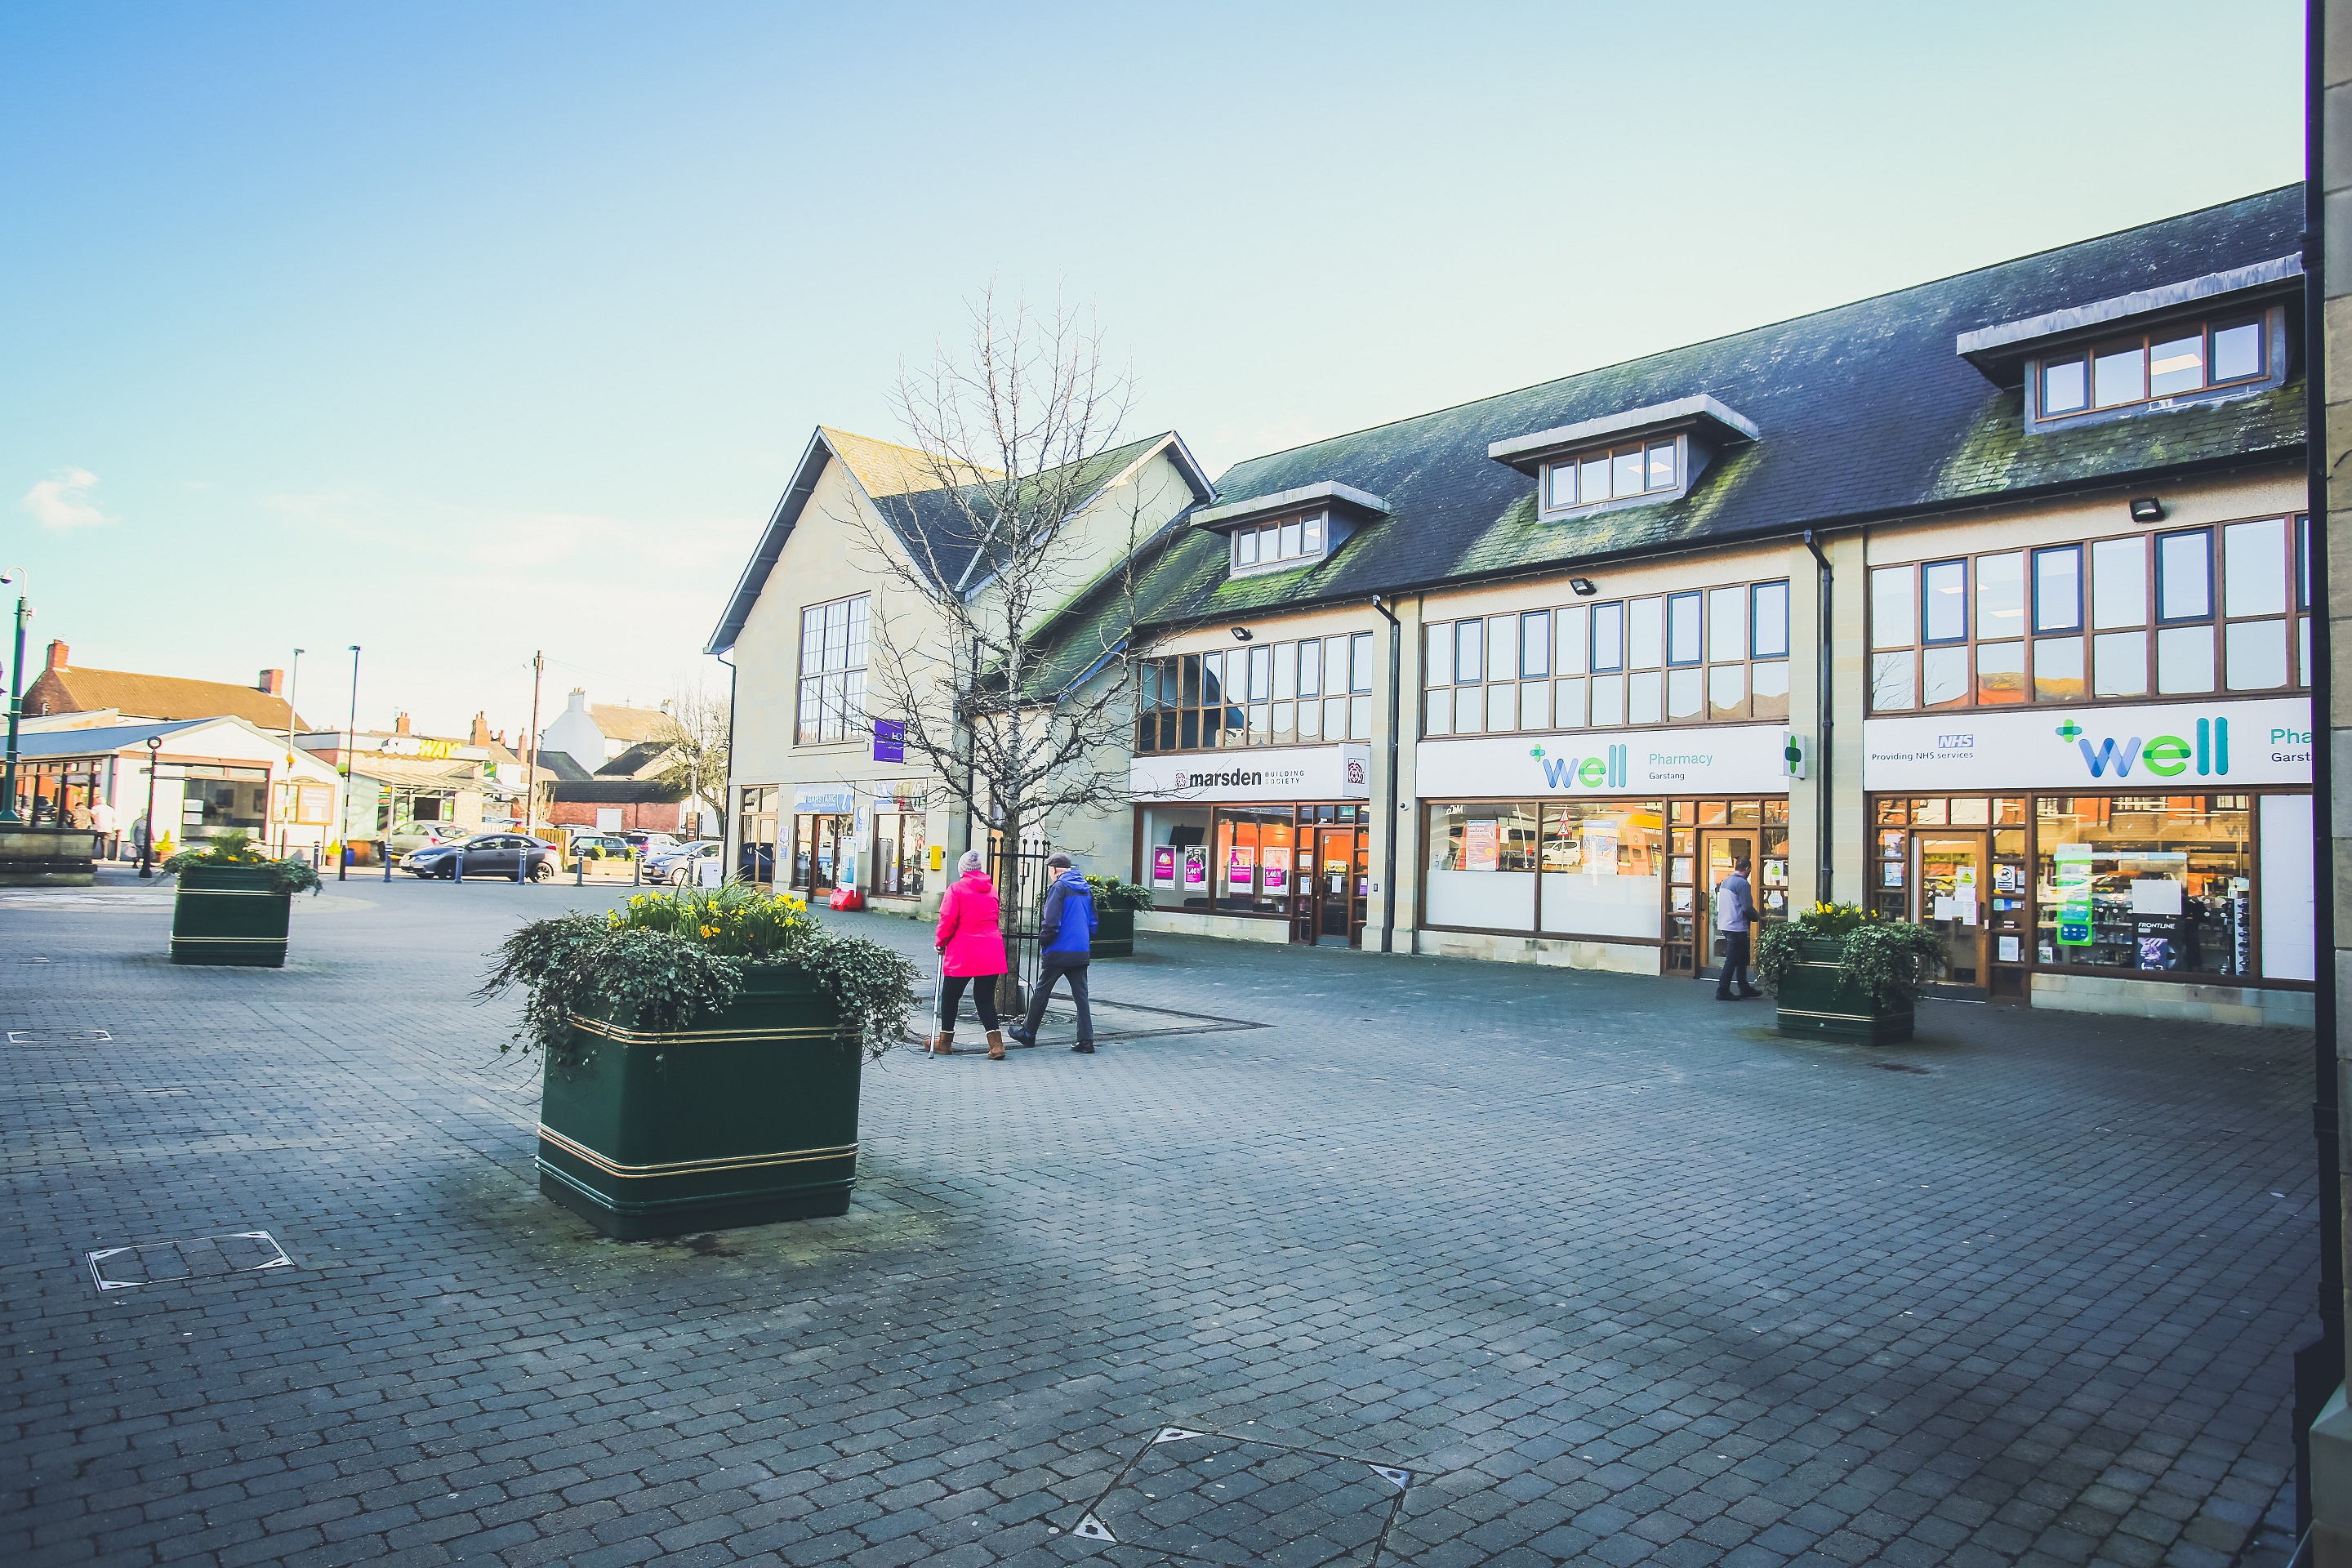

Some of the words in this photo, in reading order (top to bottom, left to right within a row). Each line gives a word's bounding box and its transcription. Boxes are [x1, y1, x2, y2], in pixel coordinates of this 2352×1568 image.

[381, 737, 462, 759] SUBWAY
[1939, 734, 1973, 748] NHS
[2078, 716, 2228, 777] well
[1649, 753, 1713, 767] Pharmacy
[1872, 753, 1913, 762] Providing
[1916, 751, 1935, 760] NHS
[1937, 751, 1974, 760] services
[1543, 744, 1627, 789] well
[1189, 768, 1262, 786] marsden
[1649, 772, 1685, 782] Garstang
[808, 794, 836, 804] GARSTANG
